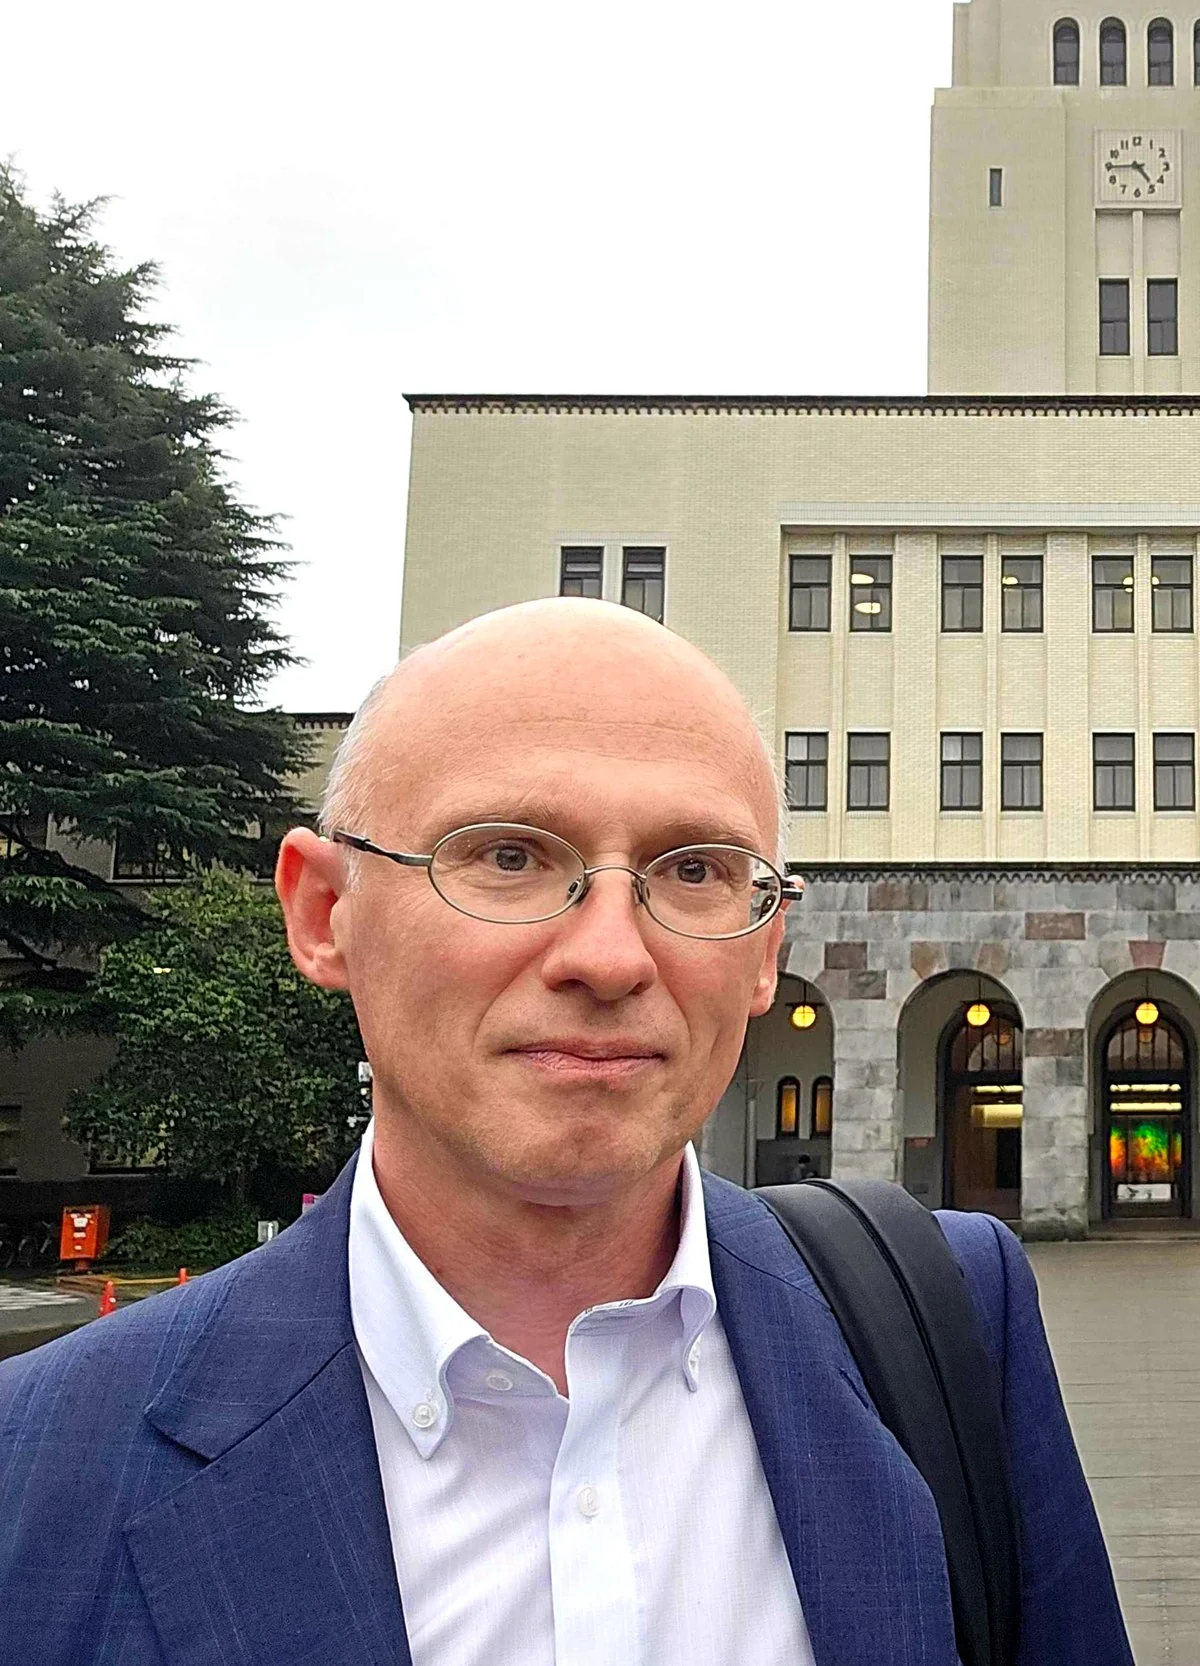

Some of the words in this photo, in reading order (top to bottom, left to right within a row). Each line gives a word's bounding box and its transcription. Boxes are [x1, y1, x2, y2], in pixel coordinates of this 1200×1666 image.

[1120, 140, 1129, 150] 11
[1149, 139, 1153, 150] 1
[1110, 149, 1119, 159] 10
[1158, 147, 1166, 158] 2
[1163, 161, 1170, 172] 3
[1108, 175, 1117, 185] 8
[1156, 174, 1164, 184] 4
[1120, 184, 1127, 194] 7
[1133, 188, 1141, 198] 6
[1147, 184, 1156, 194] 5
